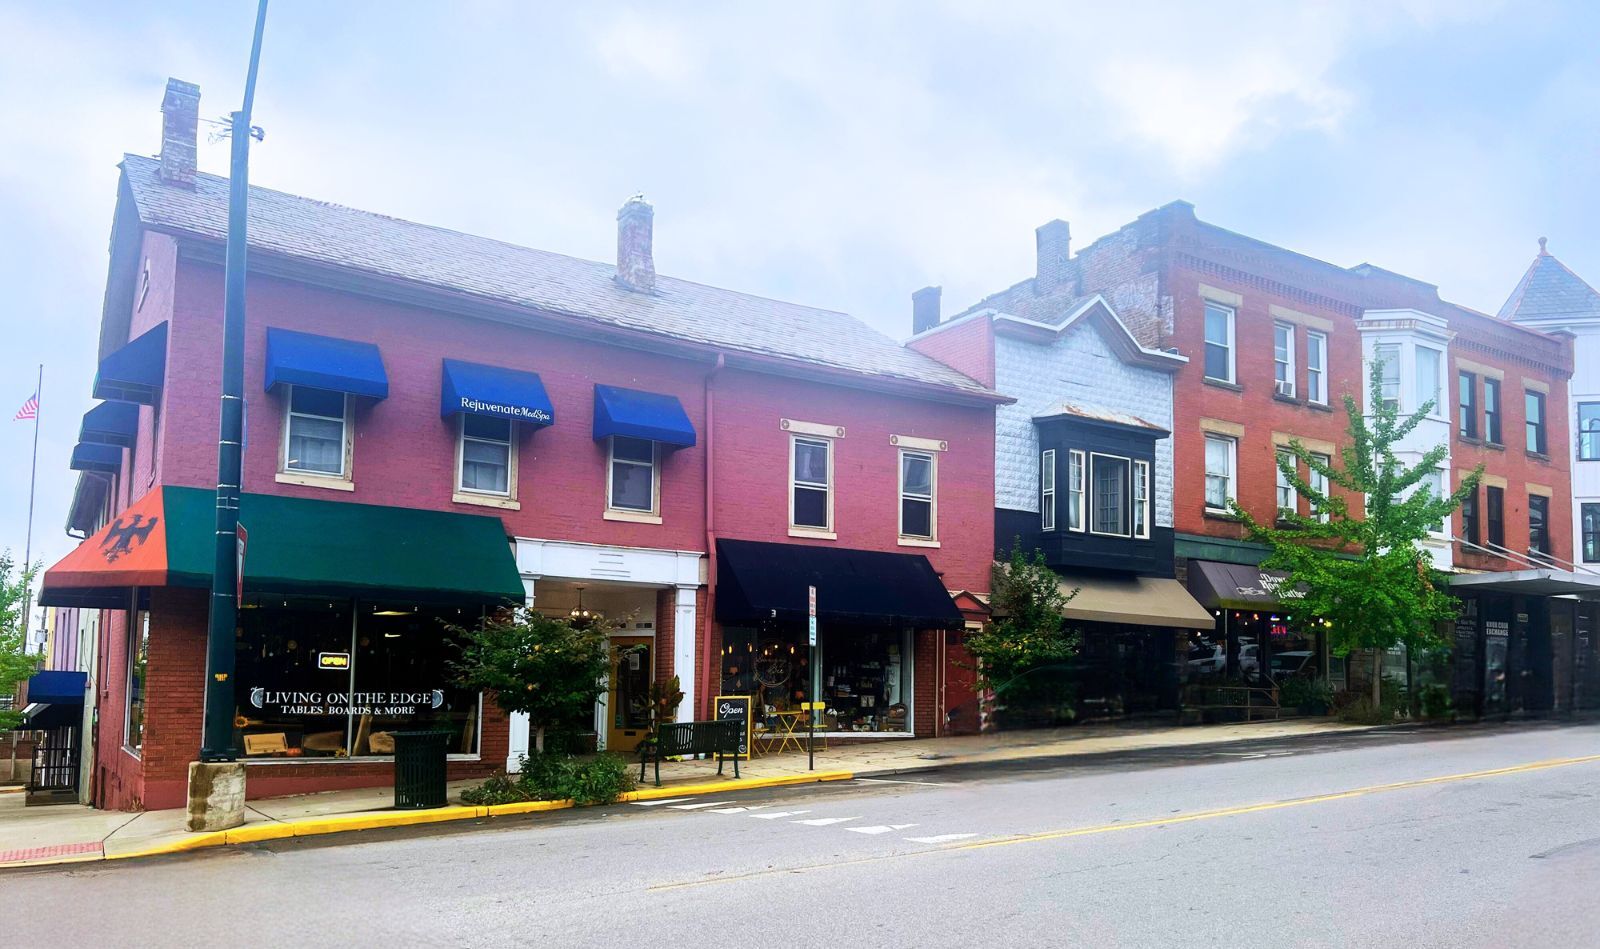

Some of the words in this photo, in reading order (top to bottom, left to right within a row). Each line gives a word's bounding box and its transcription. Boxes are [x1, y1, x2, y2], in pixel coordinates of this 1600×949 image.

[322, 656, 347, 666] OPEN
[265, 691, 322, 704] LIVING
[327, 692, 351, 704] ON
[356, 692, 386, 704] THE
[391, 693, 432, 705] EDGE
[281, 705, 323, 715] TABLES
[328, 706, 371, 715] BOARDS
[374, 707, 382, 715] &
[384, 706, 416, 715] MORE
[719, 702, 743, 719] Open
